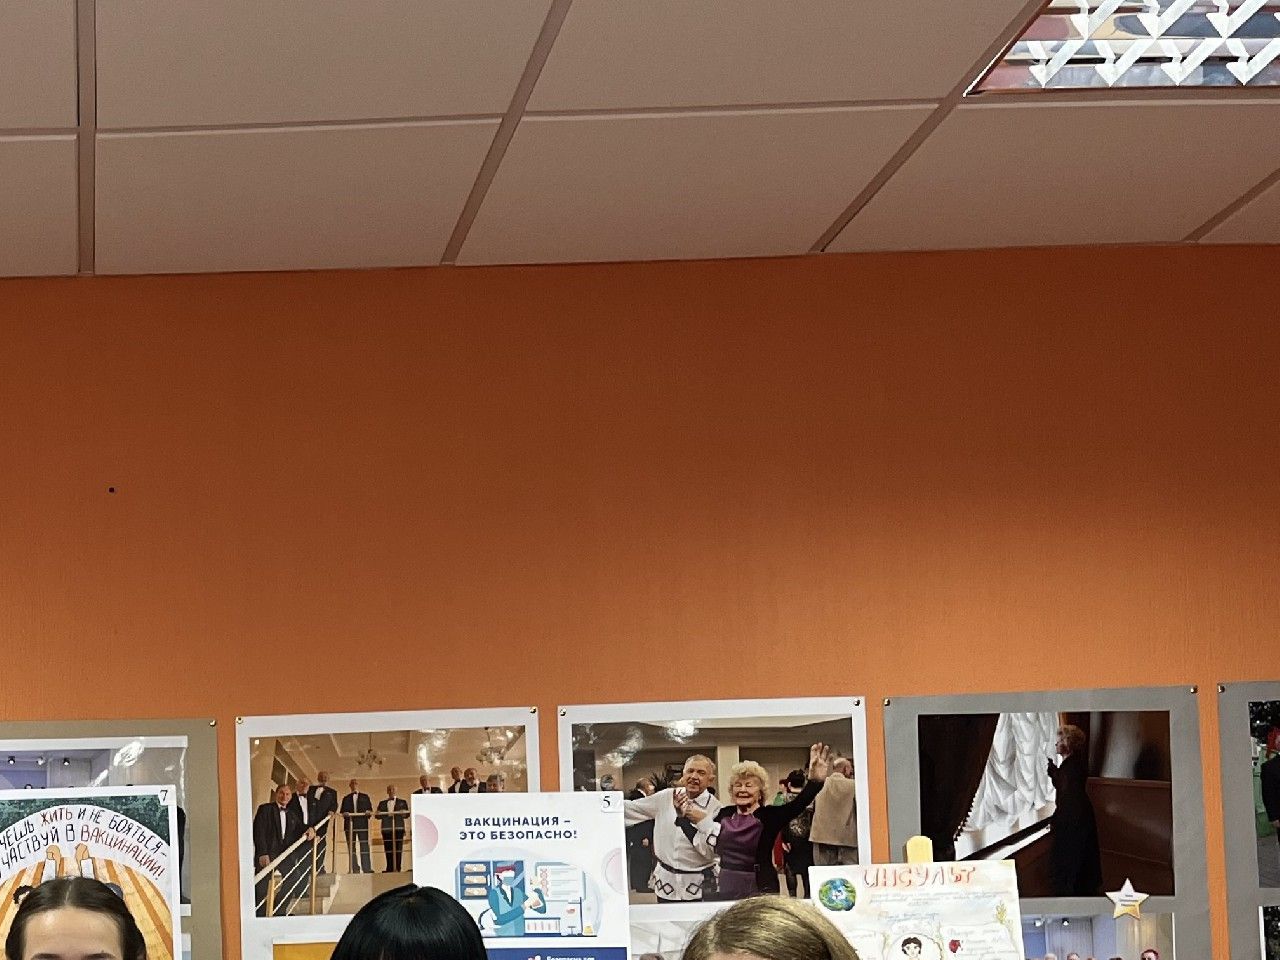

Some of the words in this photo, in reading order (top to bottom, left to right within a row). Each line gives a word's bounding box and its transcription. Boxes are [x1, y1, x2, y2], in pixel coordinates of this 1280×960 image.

[160, 790, 168, 802] 7
[602, 796, 611, 809] 5
[40, 807, 72, 826] ЖИТЬ
[77, 808, 87, 819] И
[89, 809, 105, 824] НЕ
[464, 816, 559, 828] ВАКЦИНАЦИЯ
[459, 831, 486, 840] ЭТО
[490, 830, 578, 840] БЕЗОПАСНО!
[65, 824, 75, 842] В
[81, 824, 165, 880] ВАКЦИНАЦИИ!
[864, 866, 976, 888] ИНСУЛЬТ
